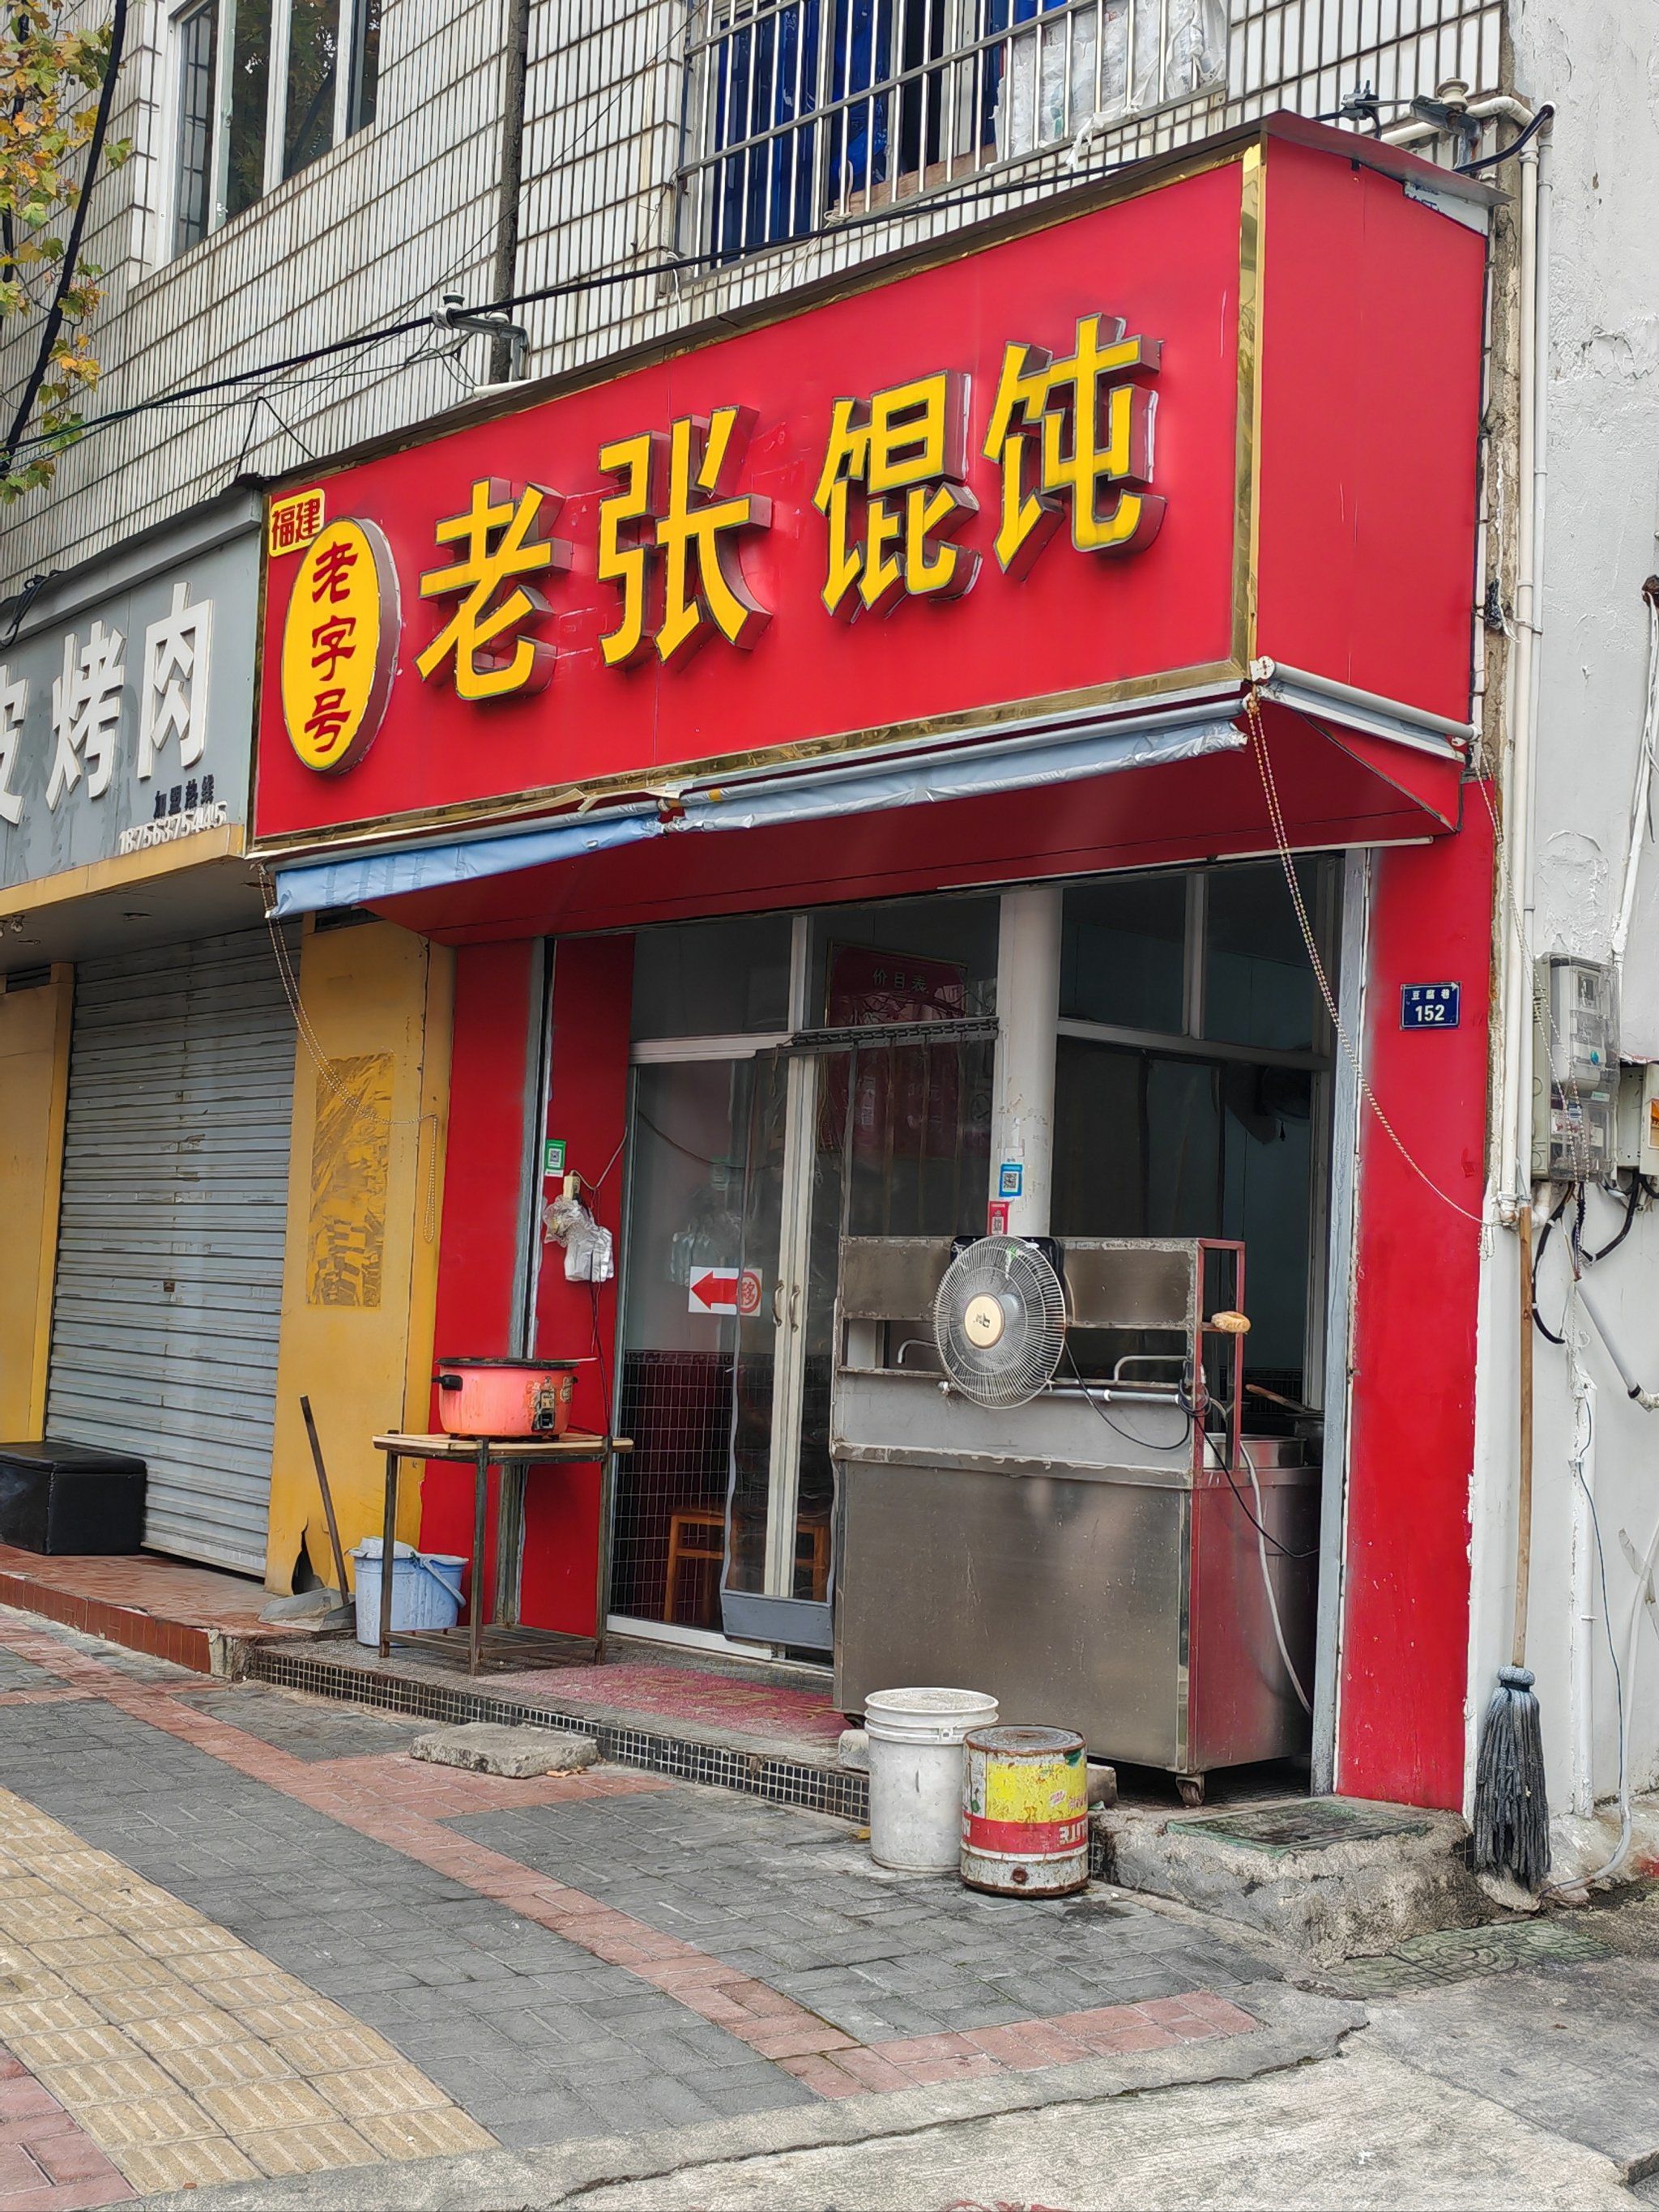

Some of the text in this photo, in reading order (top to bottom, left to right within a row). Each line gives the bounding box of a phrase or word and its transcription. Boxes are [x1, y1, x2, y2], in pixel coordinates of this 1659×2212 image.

[271, 497, 321, 551] 福建
[416, 313, 1165, 701] 老张馄饨
[305, 540, 359, 752] 老字号
[872, 966, 928, 992] 价目表
[1415, 1004, 1445, 1021] 152
